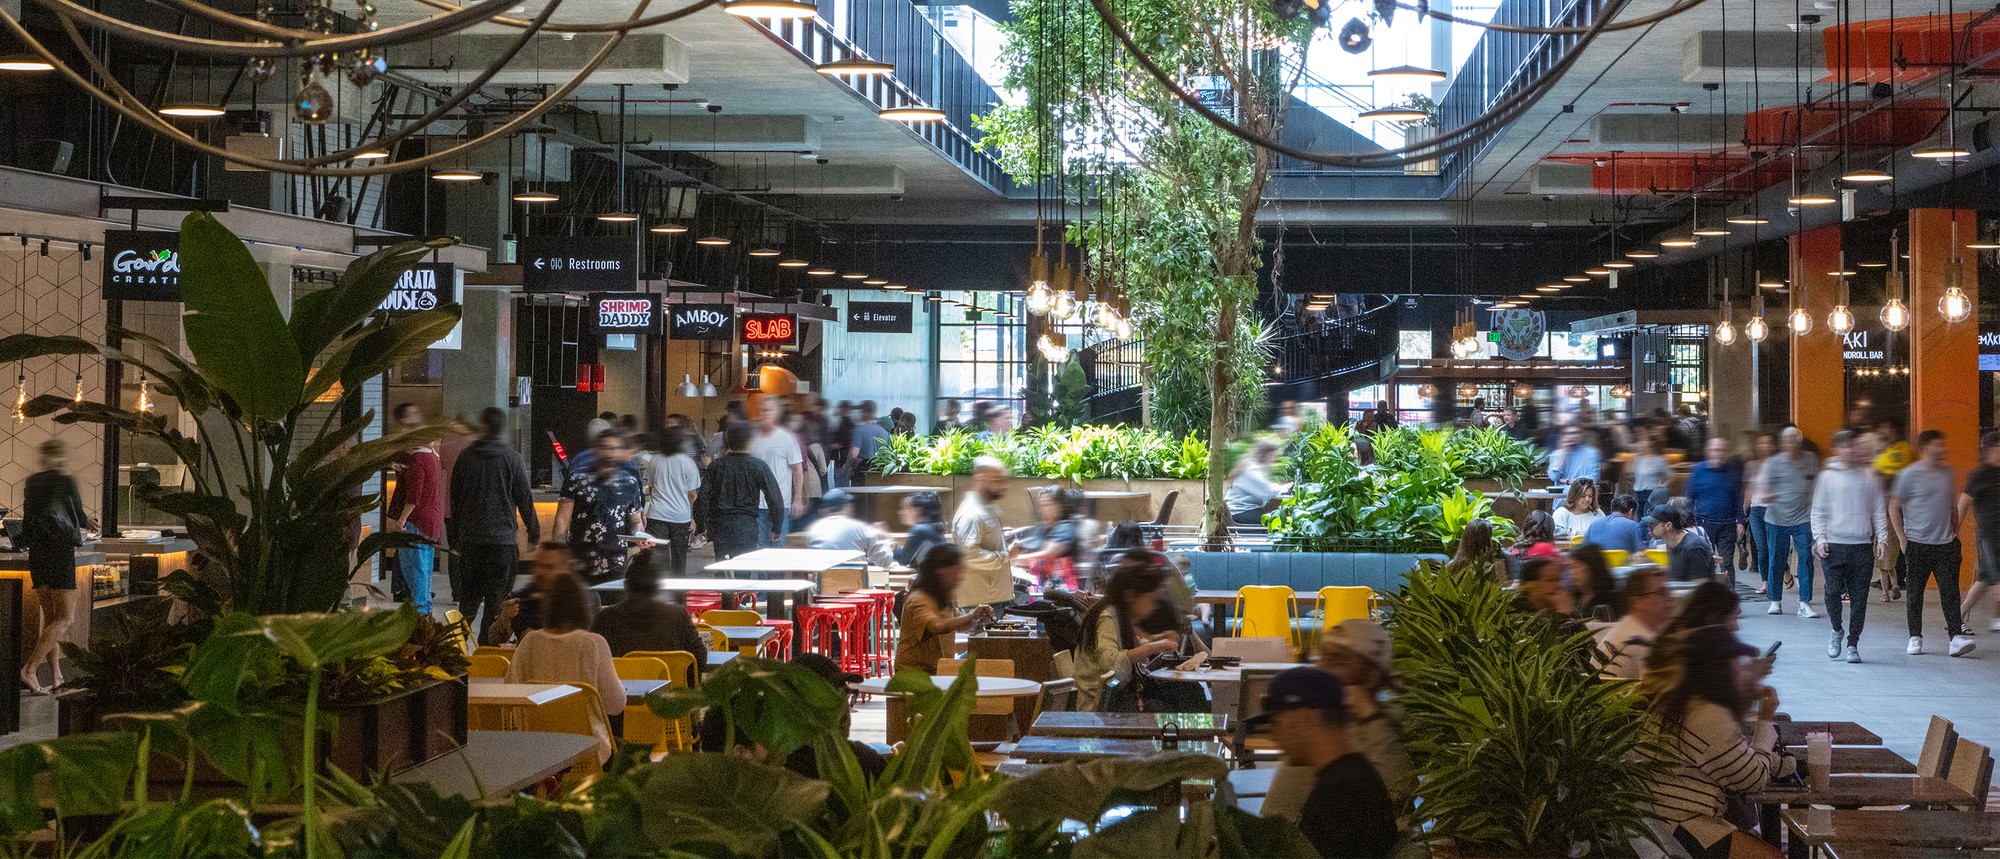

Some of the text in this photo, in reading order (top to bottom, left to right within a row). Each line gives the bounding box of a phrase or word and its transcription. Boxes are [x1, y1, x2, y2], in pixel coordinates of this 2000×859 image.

[113, 249, 180, 273] Gard
[569, 257, 620, 270] Restrooms
[112, 275, 177, 284] CREATI
[600, 300, 651, 313] SHRIMP
[599, 312, 650, 327] DADDY
[676, 309, 729, 328] AMBOY
[745, 319, 791, 339] SLAB
[1843, 331, 1867, 349] AKI
[1843, 351, 1883, 359] NDROLL BAR
